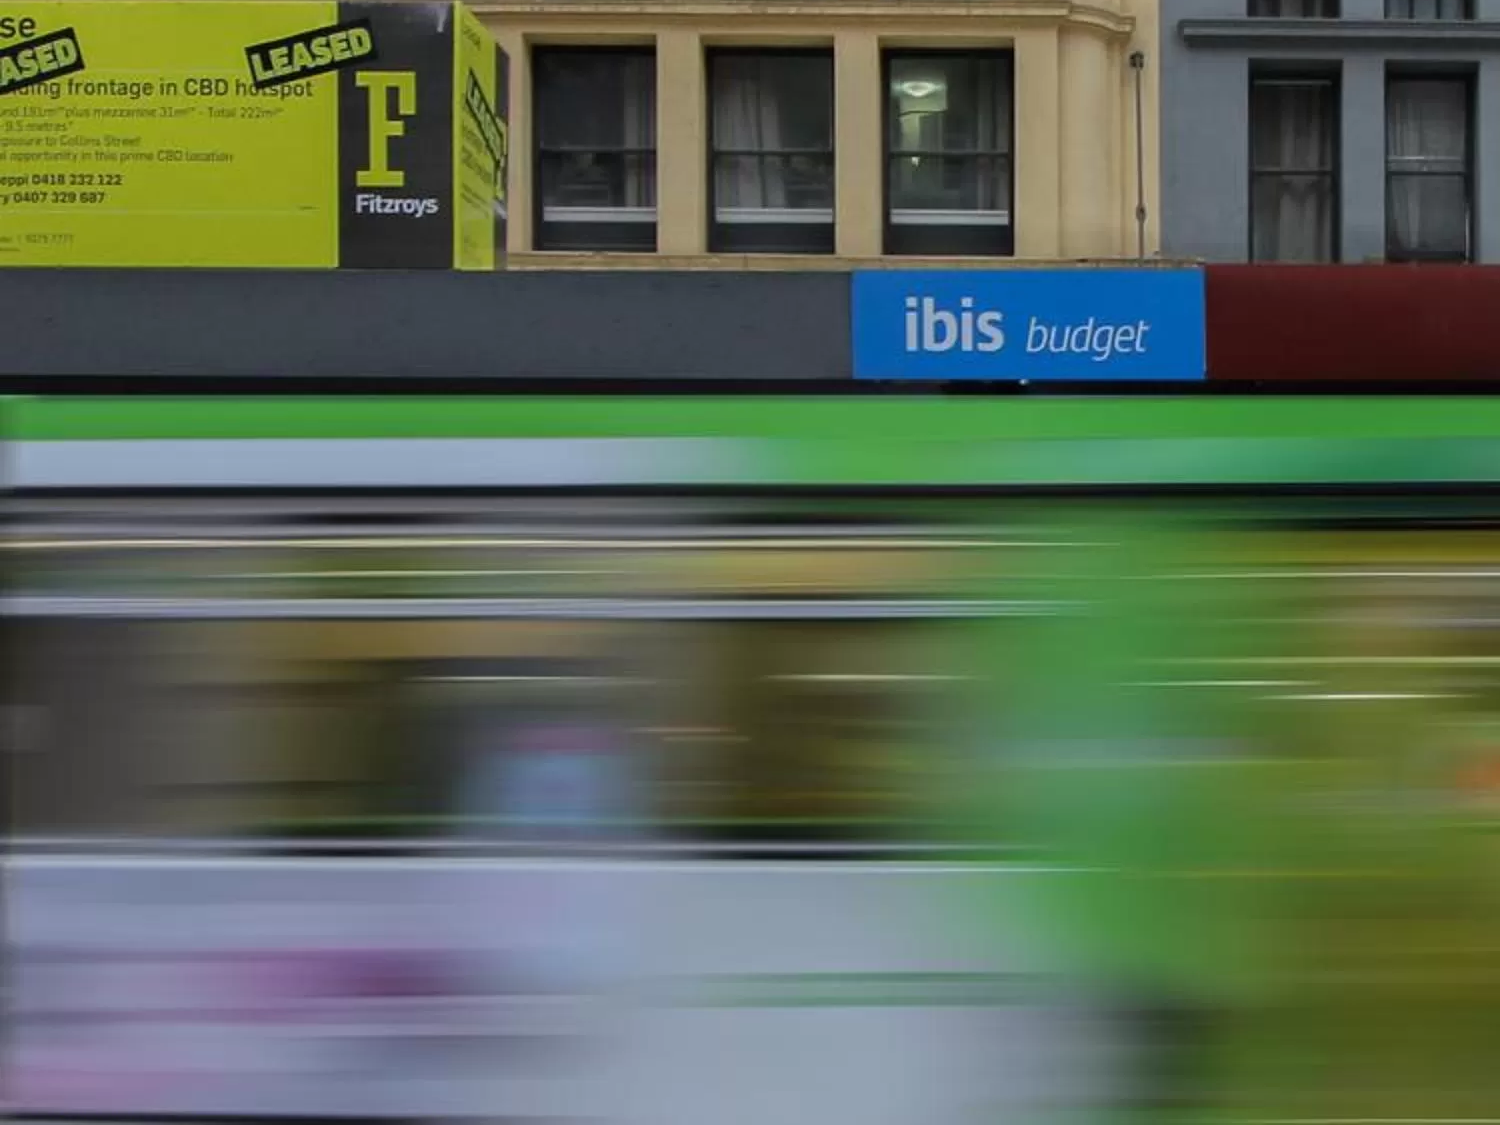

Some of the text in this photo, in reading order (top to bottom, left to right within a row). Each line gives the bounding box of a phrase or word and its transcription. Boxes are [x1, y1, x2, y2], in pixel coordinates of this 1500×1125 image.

[251, 27, 371, 81] LEASED
[67, 78, 155, 100] frontage
[159, 78, 178, 96] in
[183, 78, 229, 97] CBD
[355, 193, 439, 218] Fitzroys
[905, 296, 1151, 362] ibis budget
